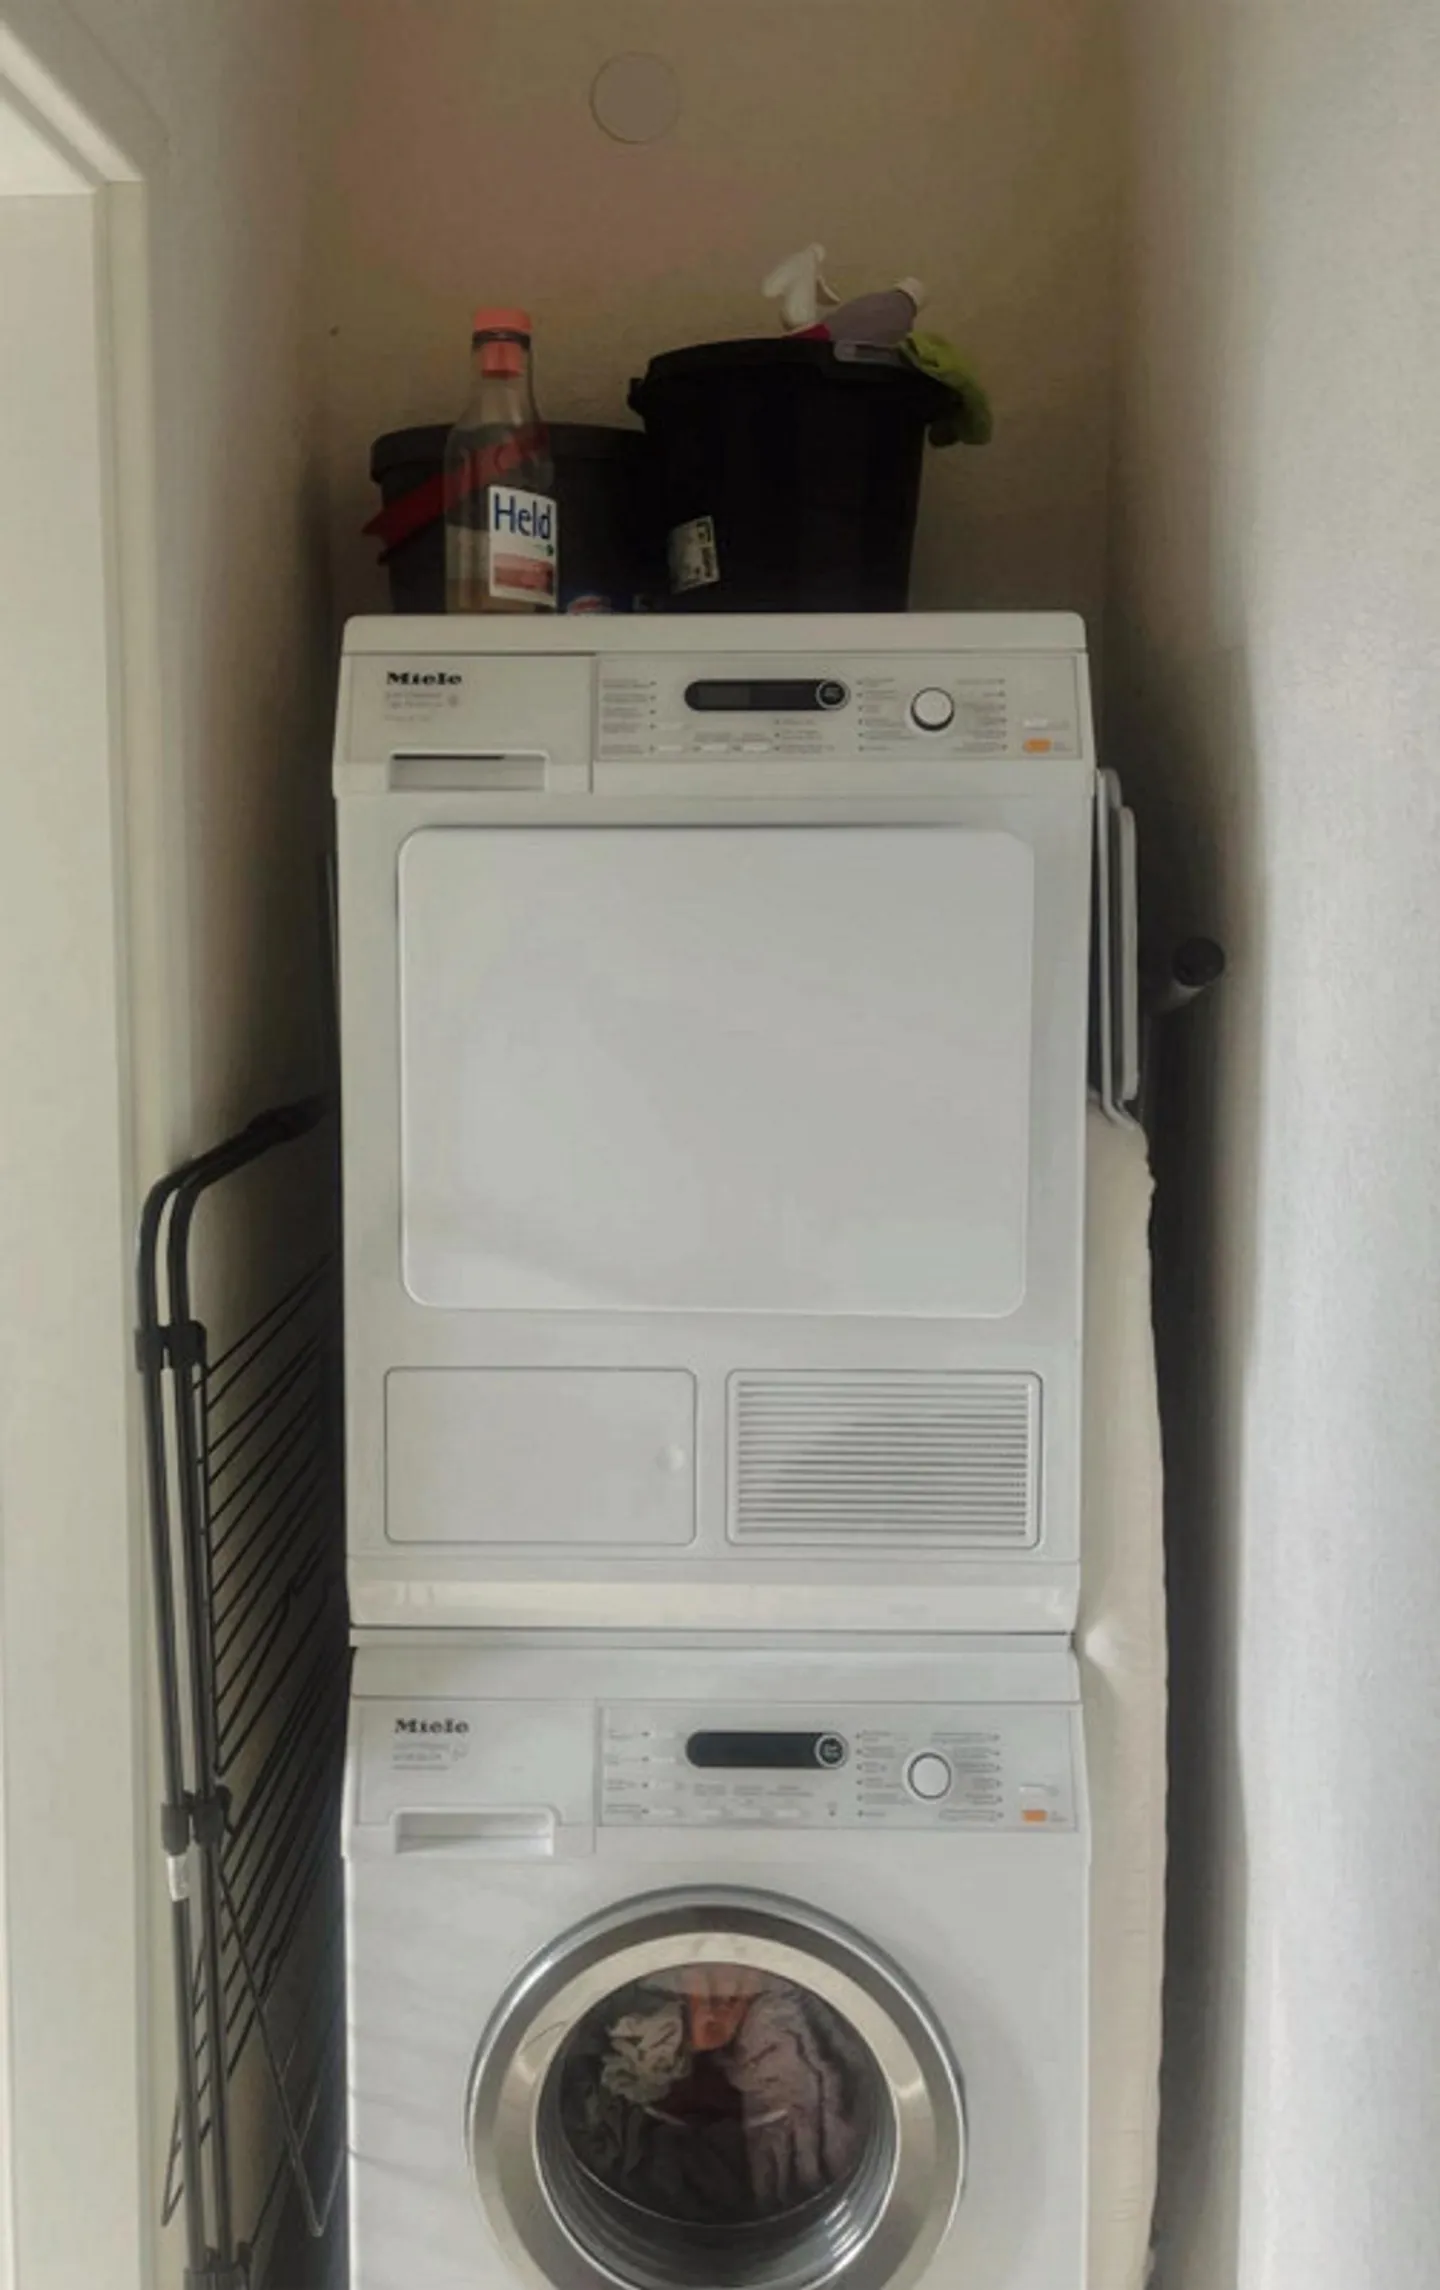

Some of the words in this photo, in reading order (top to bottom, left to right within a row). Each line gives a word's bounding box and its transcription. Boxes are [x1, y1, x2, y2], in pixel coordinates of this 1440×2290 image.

[494, 492, 551, 540] Held
[387, 672, 462, 685] Miele
[395, 1718, 469, 1733] Miele
